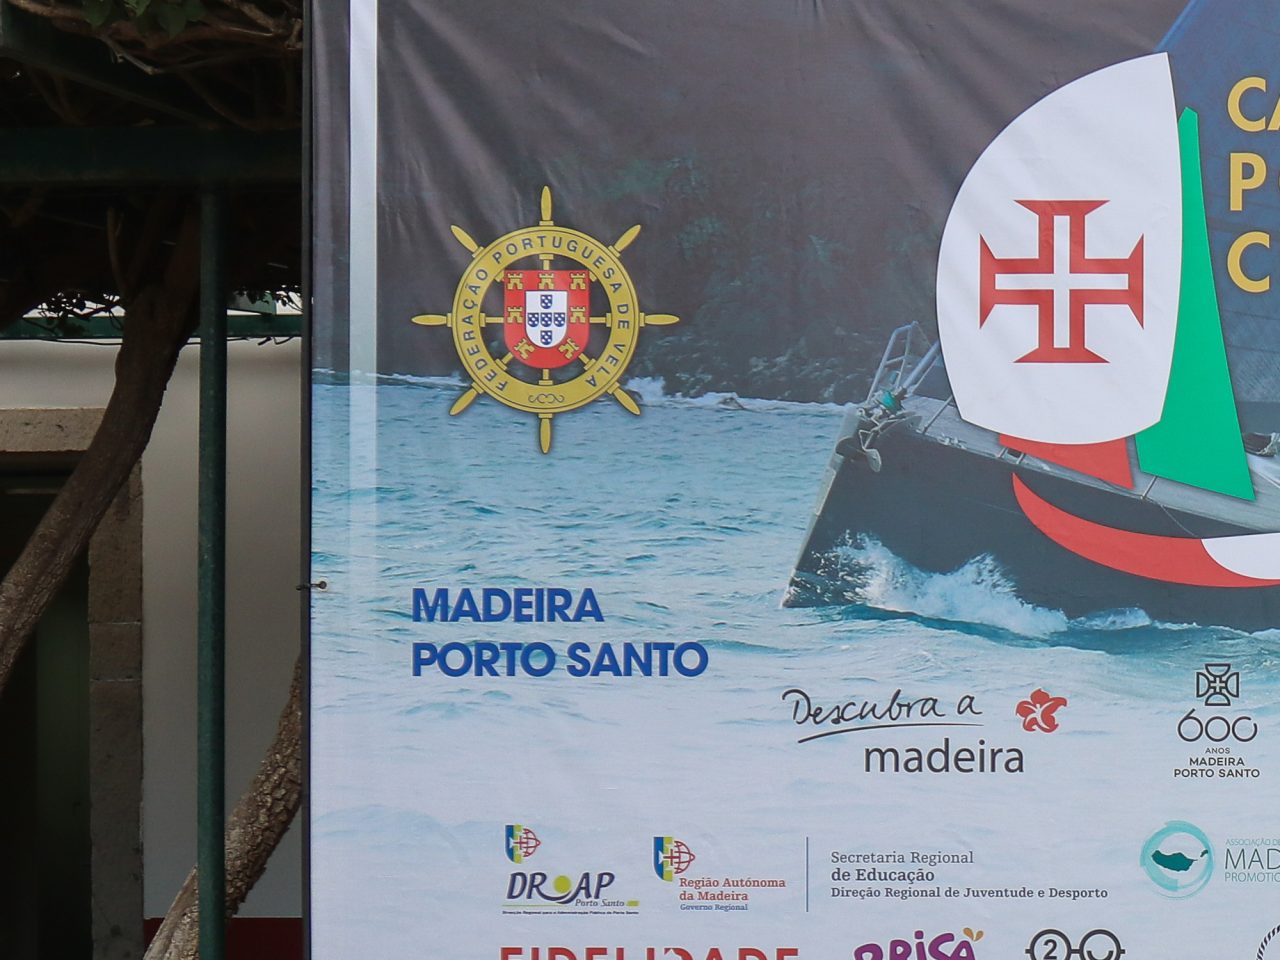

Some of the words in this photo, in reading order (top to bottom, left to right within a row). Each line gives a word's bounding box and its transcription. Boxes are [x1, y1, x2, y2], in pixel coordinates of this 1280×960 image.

[492, 235, 622, 294] PORTUGUESA
[618, 303, 630, 330] DE
[462, 267, 509, 392] FEDERAÇÃO
[584, 343, 626, 388] VELA
[412, 587, 605, 623] MADEIRA
[412, 642, 556, 677] PORTO
[566, 642, 709, 677] SANTO
[781, 687, 945, 726] Descubra
[956, 694, 983, 717] a
[864, 737, 1025, 774] madeira
[1205, 747, 1231, 755] ANOS
[1189, 757, 1245, 767] MADEIRA
[1173, 768, 1215, 778] PORTO
[1218, 769, 1260, 779] SANTO
[831, 851, 905, 864] Secretaria
[910, 851, 974, 867] Regional
[680, 877, 719, 890] Região
[722, 877, 786, 888] Autónoma
[831, 868, 850, 881] de
[855, 868, 935, 884] Educação
[679, 891, 694, 901] da
[698, 890, 748, 901] Madeira
[831, 887, 881, 901] Direção
[885, 887, 940, 900] Regional
[945, 887, 960, 898] de
[963, 887, 1034, 898] Juventude
[1037, 890, 1044, 898] e
[1049, 888, 1108, 901] Desporto
[680, 903, 713, 911] Governo
[715, 903, 748, 912] Regional
